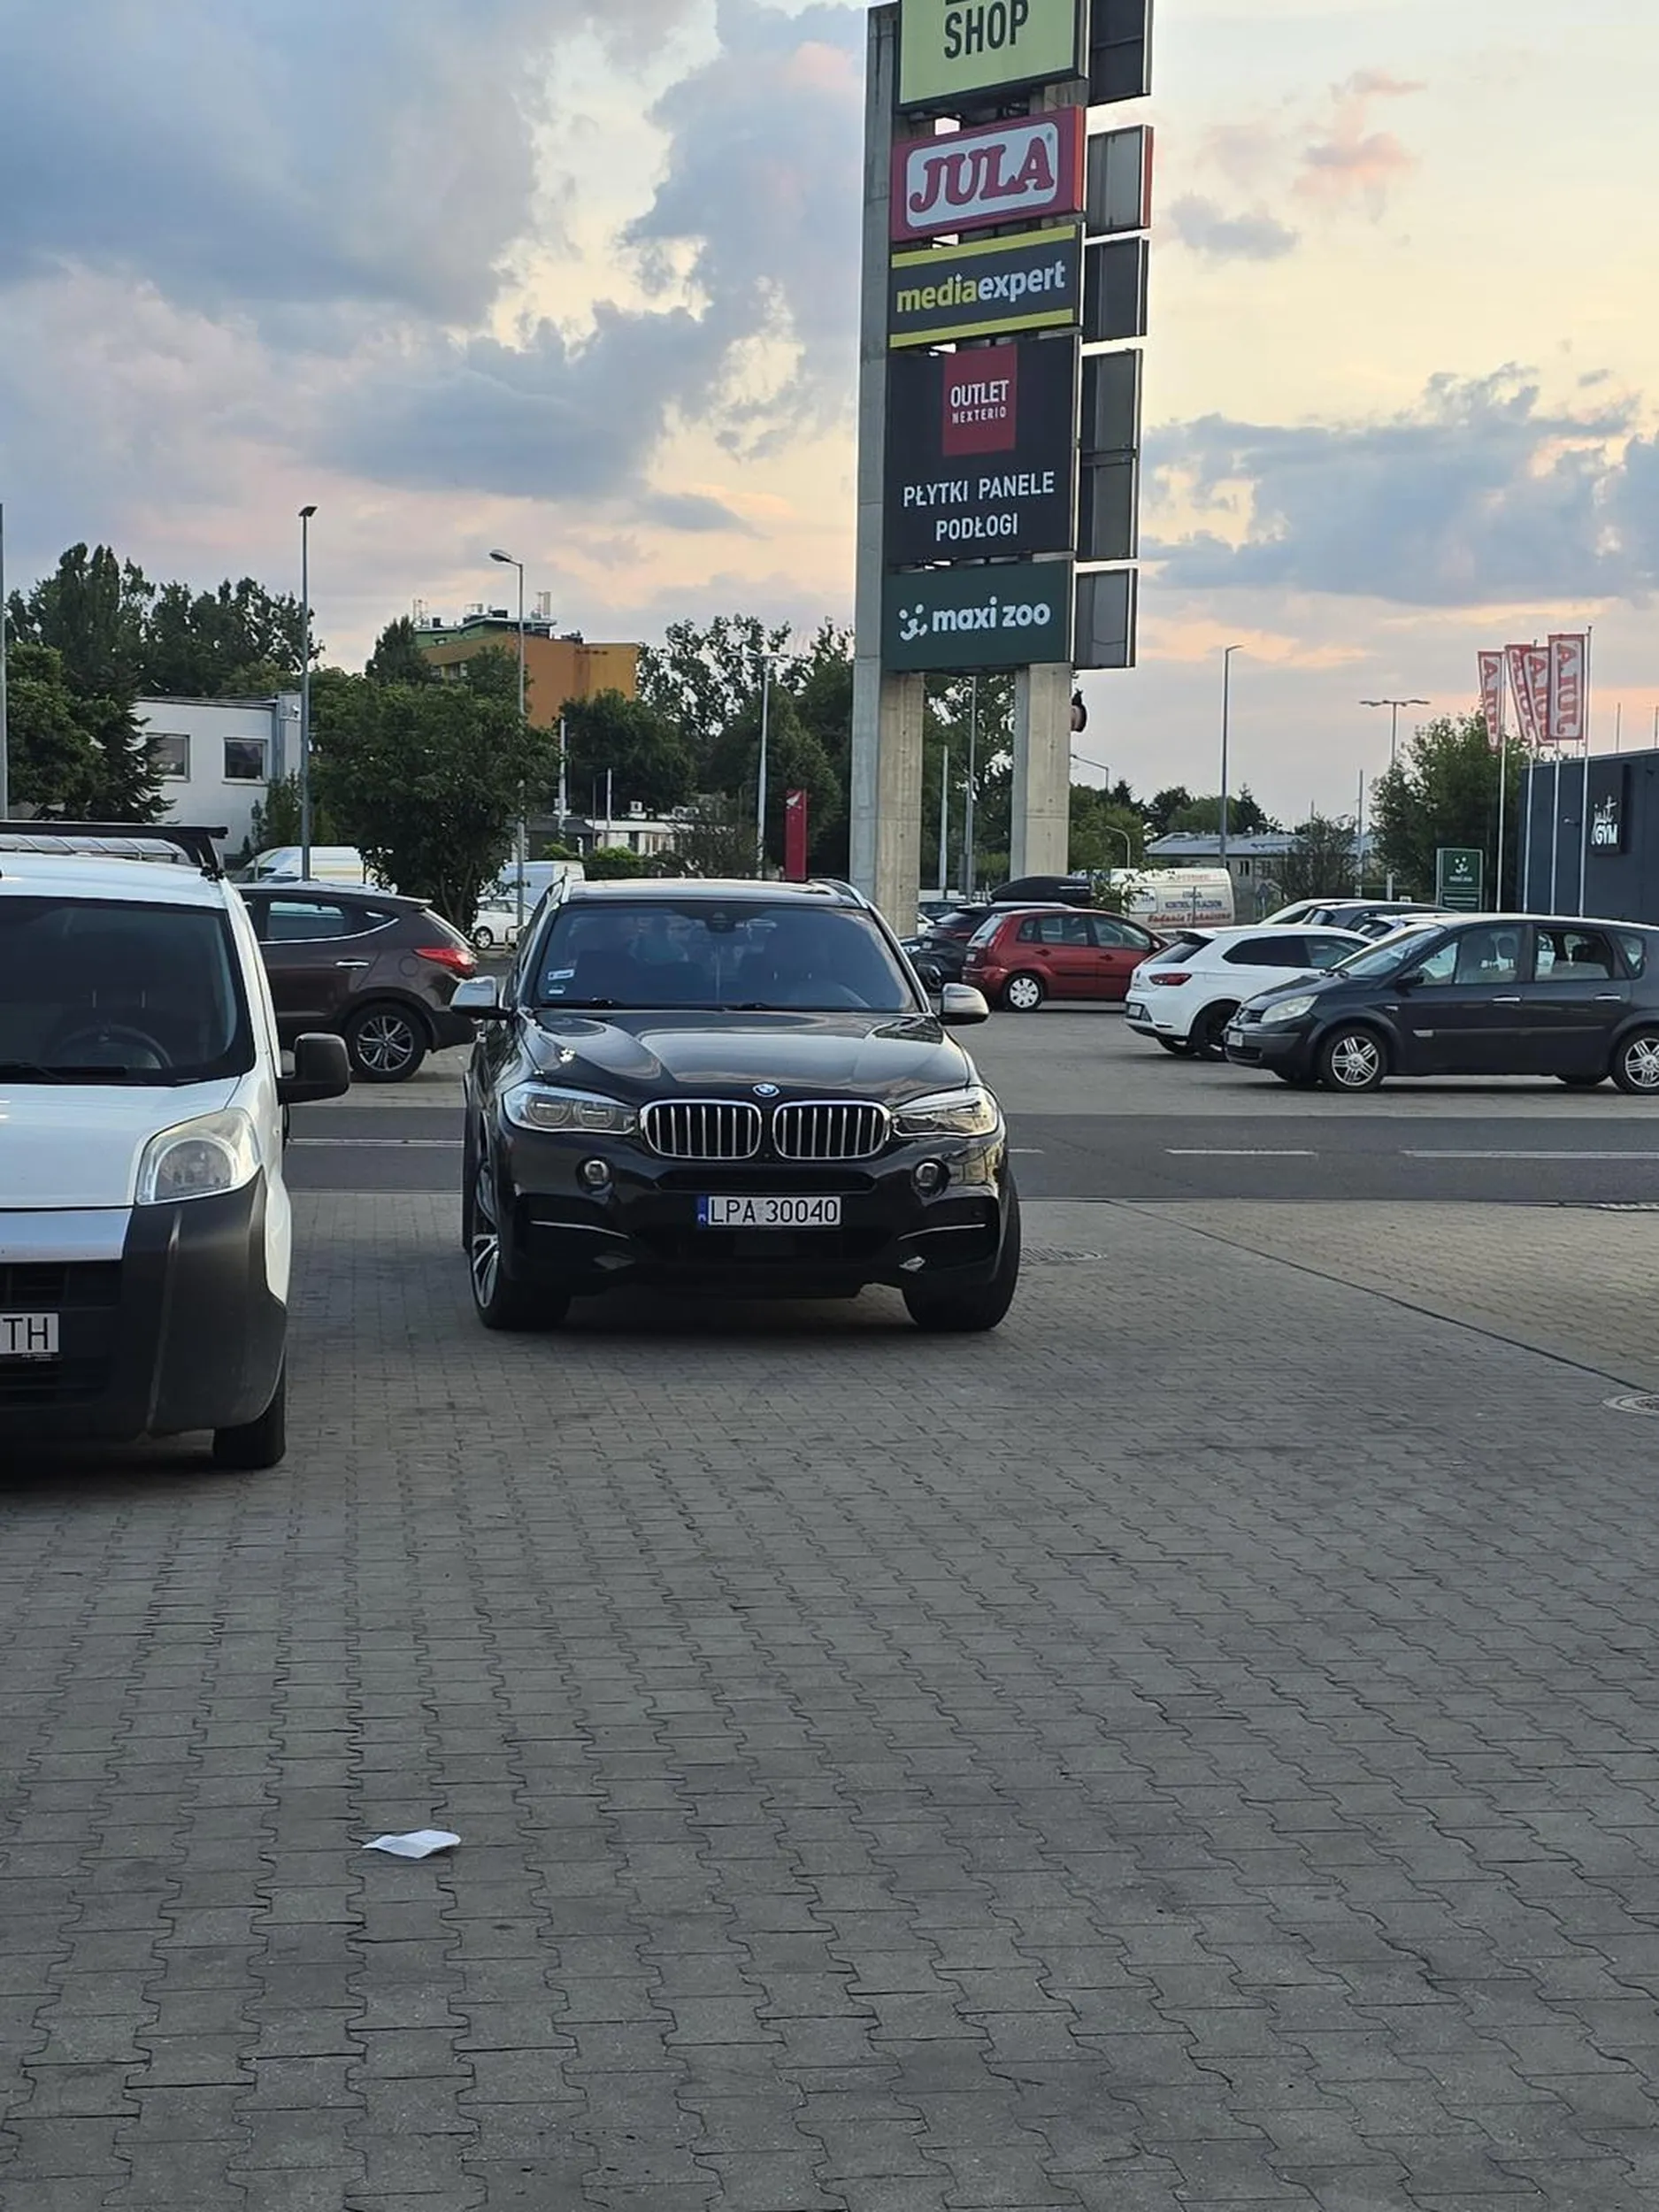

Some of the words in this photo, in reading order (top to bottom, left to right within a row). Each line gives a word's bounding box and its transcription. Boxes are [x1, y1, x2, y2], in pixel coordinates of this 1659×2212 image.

[944, 0, 1028, 58] SHOP
[910, 136, 1055, 212] JULA
[896, 261, 1065, 313] mediaexpert
[950, 380, 1010, 407] OUTLET
[951, 406, 1007, 424] NEXTERIO
[903, 480, 968, 507] PŁYTKI
[979, 471, 1055, 500] PANELE
[936, 513, 1018, 541] PODŁOGI
[933, 596, 996, 632] maxi
[1002, 603, 1051, 627] zoo
[710, 1200, 756, 1223] LPA
[765, 1200, 837, 1223] 30040
[3, 1317, 48, 1351] TH
